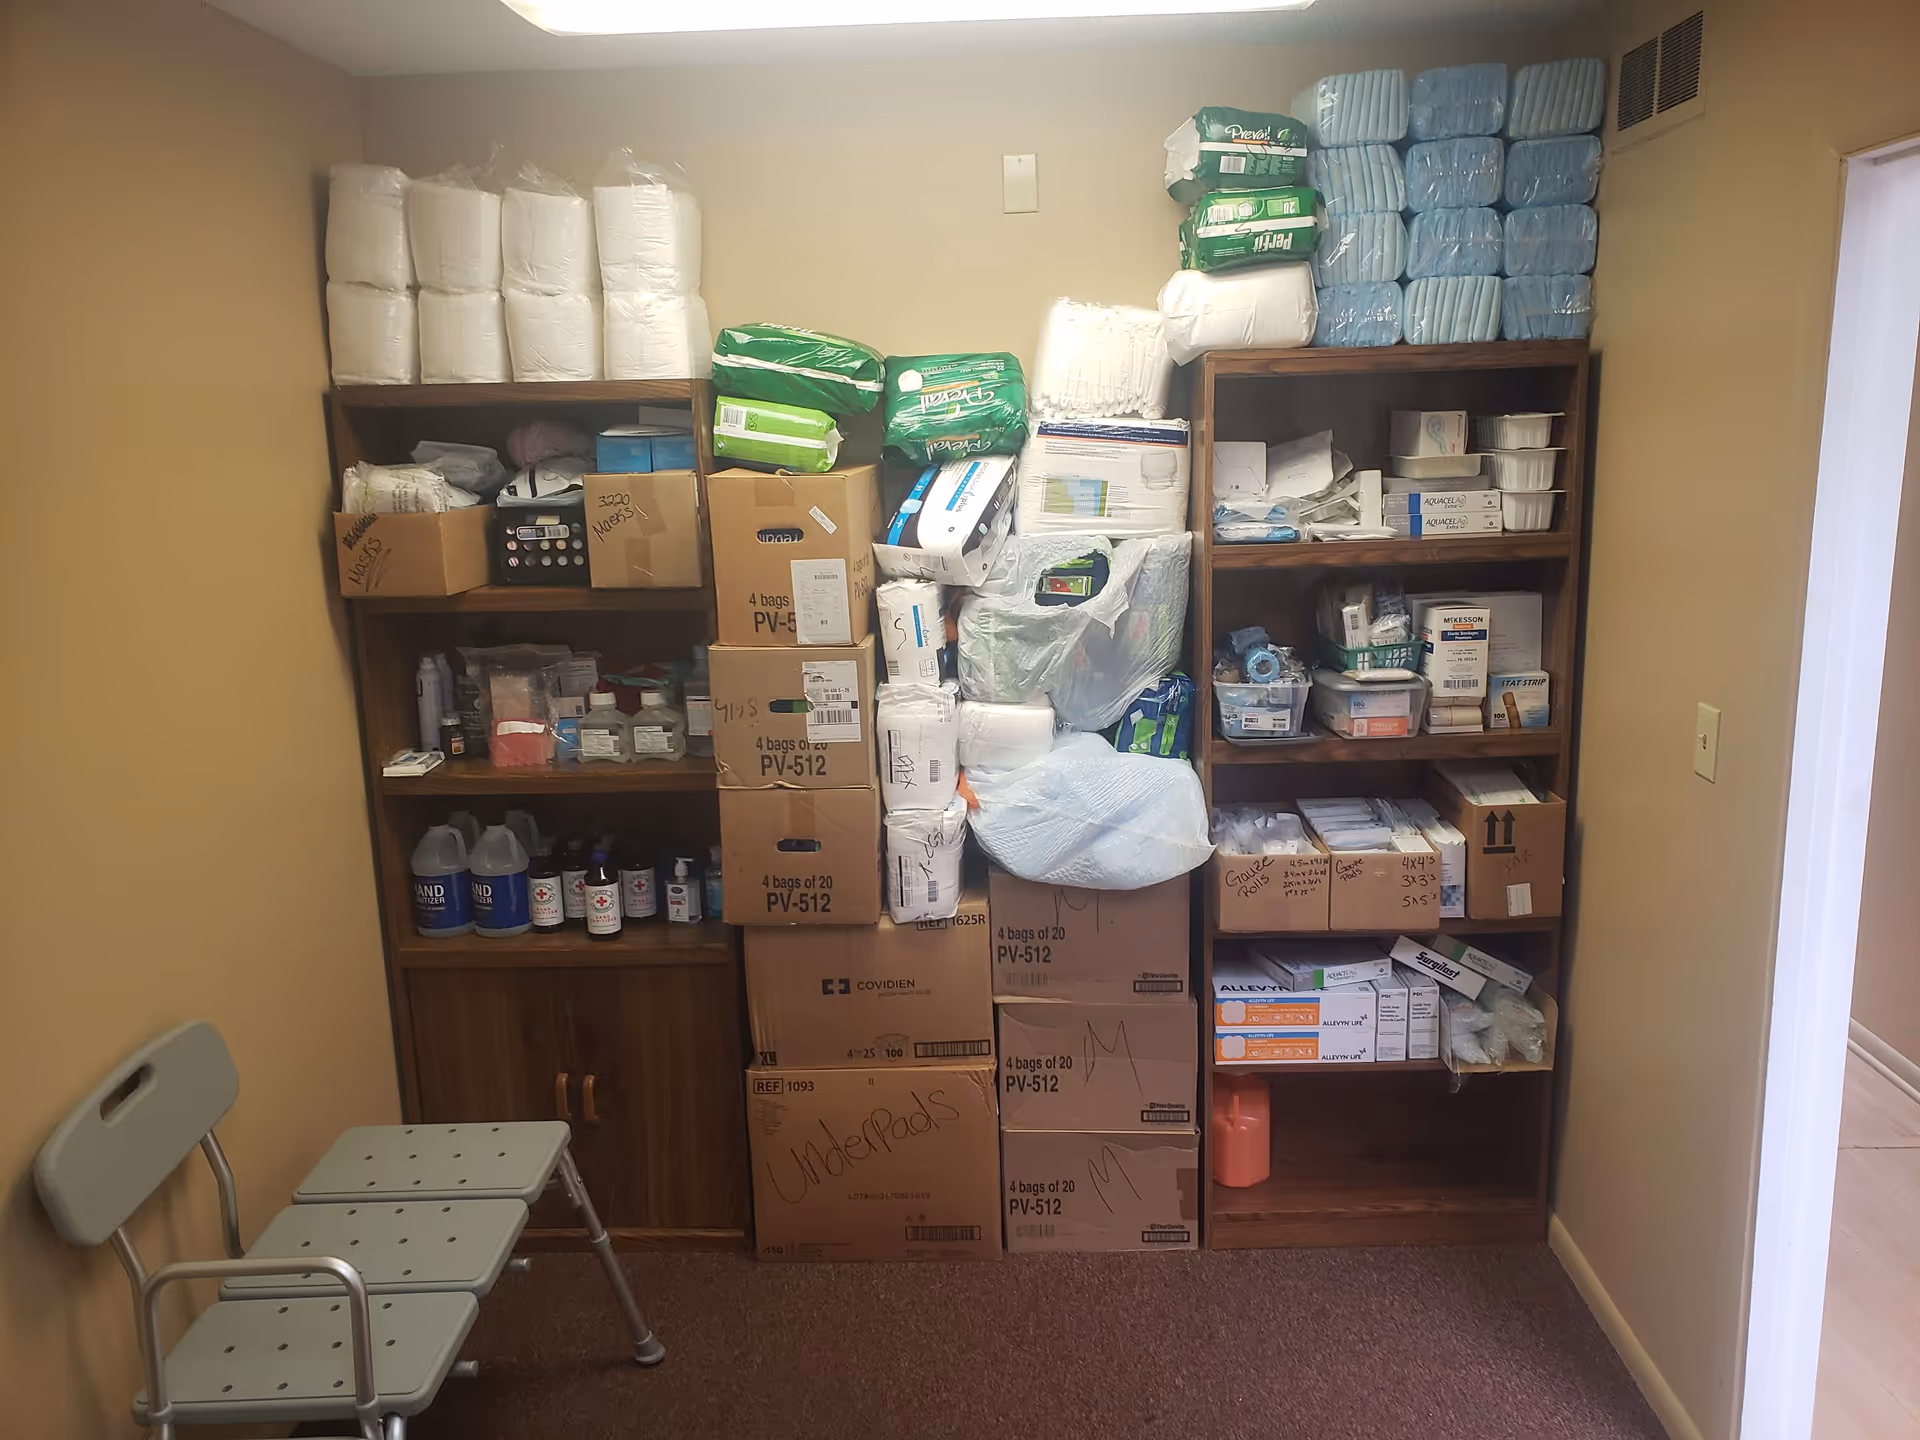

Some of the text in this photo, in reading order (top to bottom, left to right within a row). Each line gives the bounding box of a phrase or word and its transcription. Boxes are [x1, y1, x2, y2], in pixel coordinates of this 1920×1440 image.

[1225, 124, 1271, 140] Prevail
[1284, 201, 1295, 214] 20
[920, 387, 994, 414] Prevail
[926, 439, 991, 461] Prevail
[1424, 497, 1456, 506] AQUACEL
[1426, 518, 1457, 526] AQUACEL
[749, 593, 789, 609] 4 bags
[754, 612, 797, 633] PV-5
[756, 737, 763, 749] 4
[767, 737, 795, 753] bags
[761, 755, 826, 776] PV-512
[1225, 856, 1275, 887] Gauze
[1340, 869, 1362, 881] Pads
[762, 875, 832, 891] 4 bags of 20
[1237, 874, 1270, 898] Rolls
[767, 892, 831, 913] PV-512
[952, 914, 986, 927] 1625R
[998, 927, 1066, 942] 4 bags of 20
[998, 946, 1051, 964] PV-512
[1415, 951, 1460, 978] Surgilast
[857, 979, 915, 991] COVIDIEN
[863, 1048, 875, 1058] 25
[886, 1048, 903, 1058] 100
[1006, 1056, 1072, 1072] 4 bags of 20
[757, 1081, 815, 1092] REF 1093
[1006, 1075, 1059, 1092] PV-512
[1009, 1180, 1075, 1196] 4 bags of 20
[1009, 1198, 1061, 1215] PV-512
